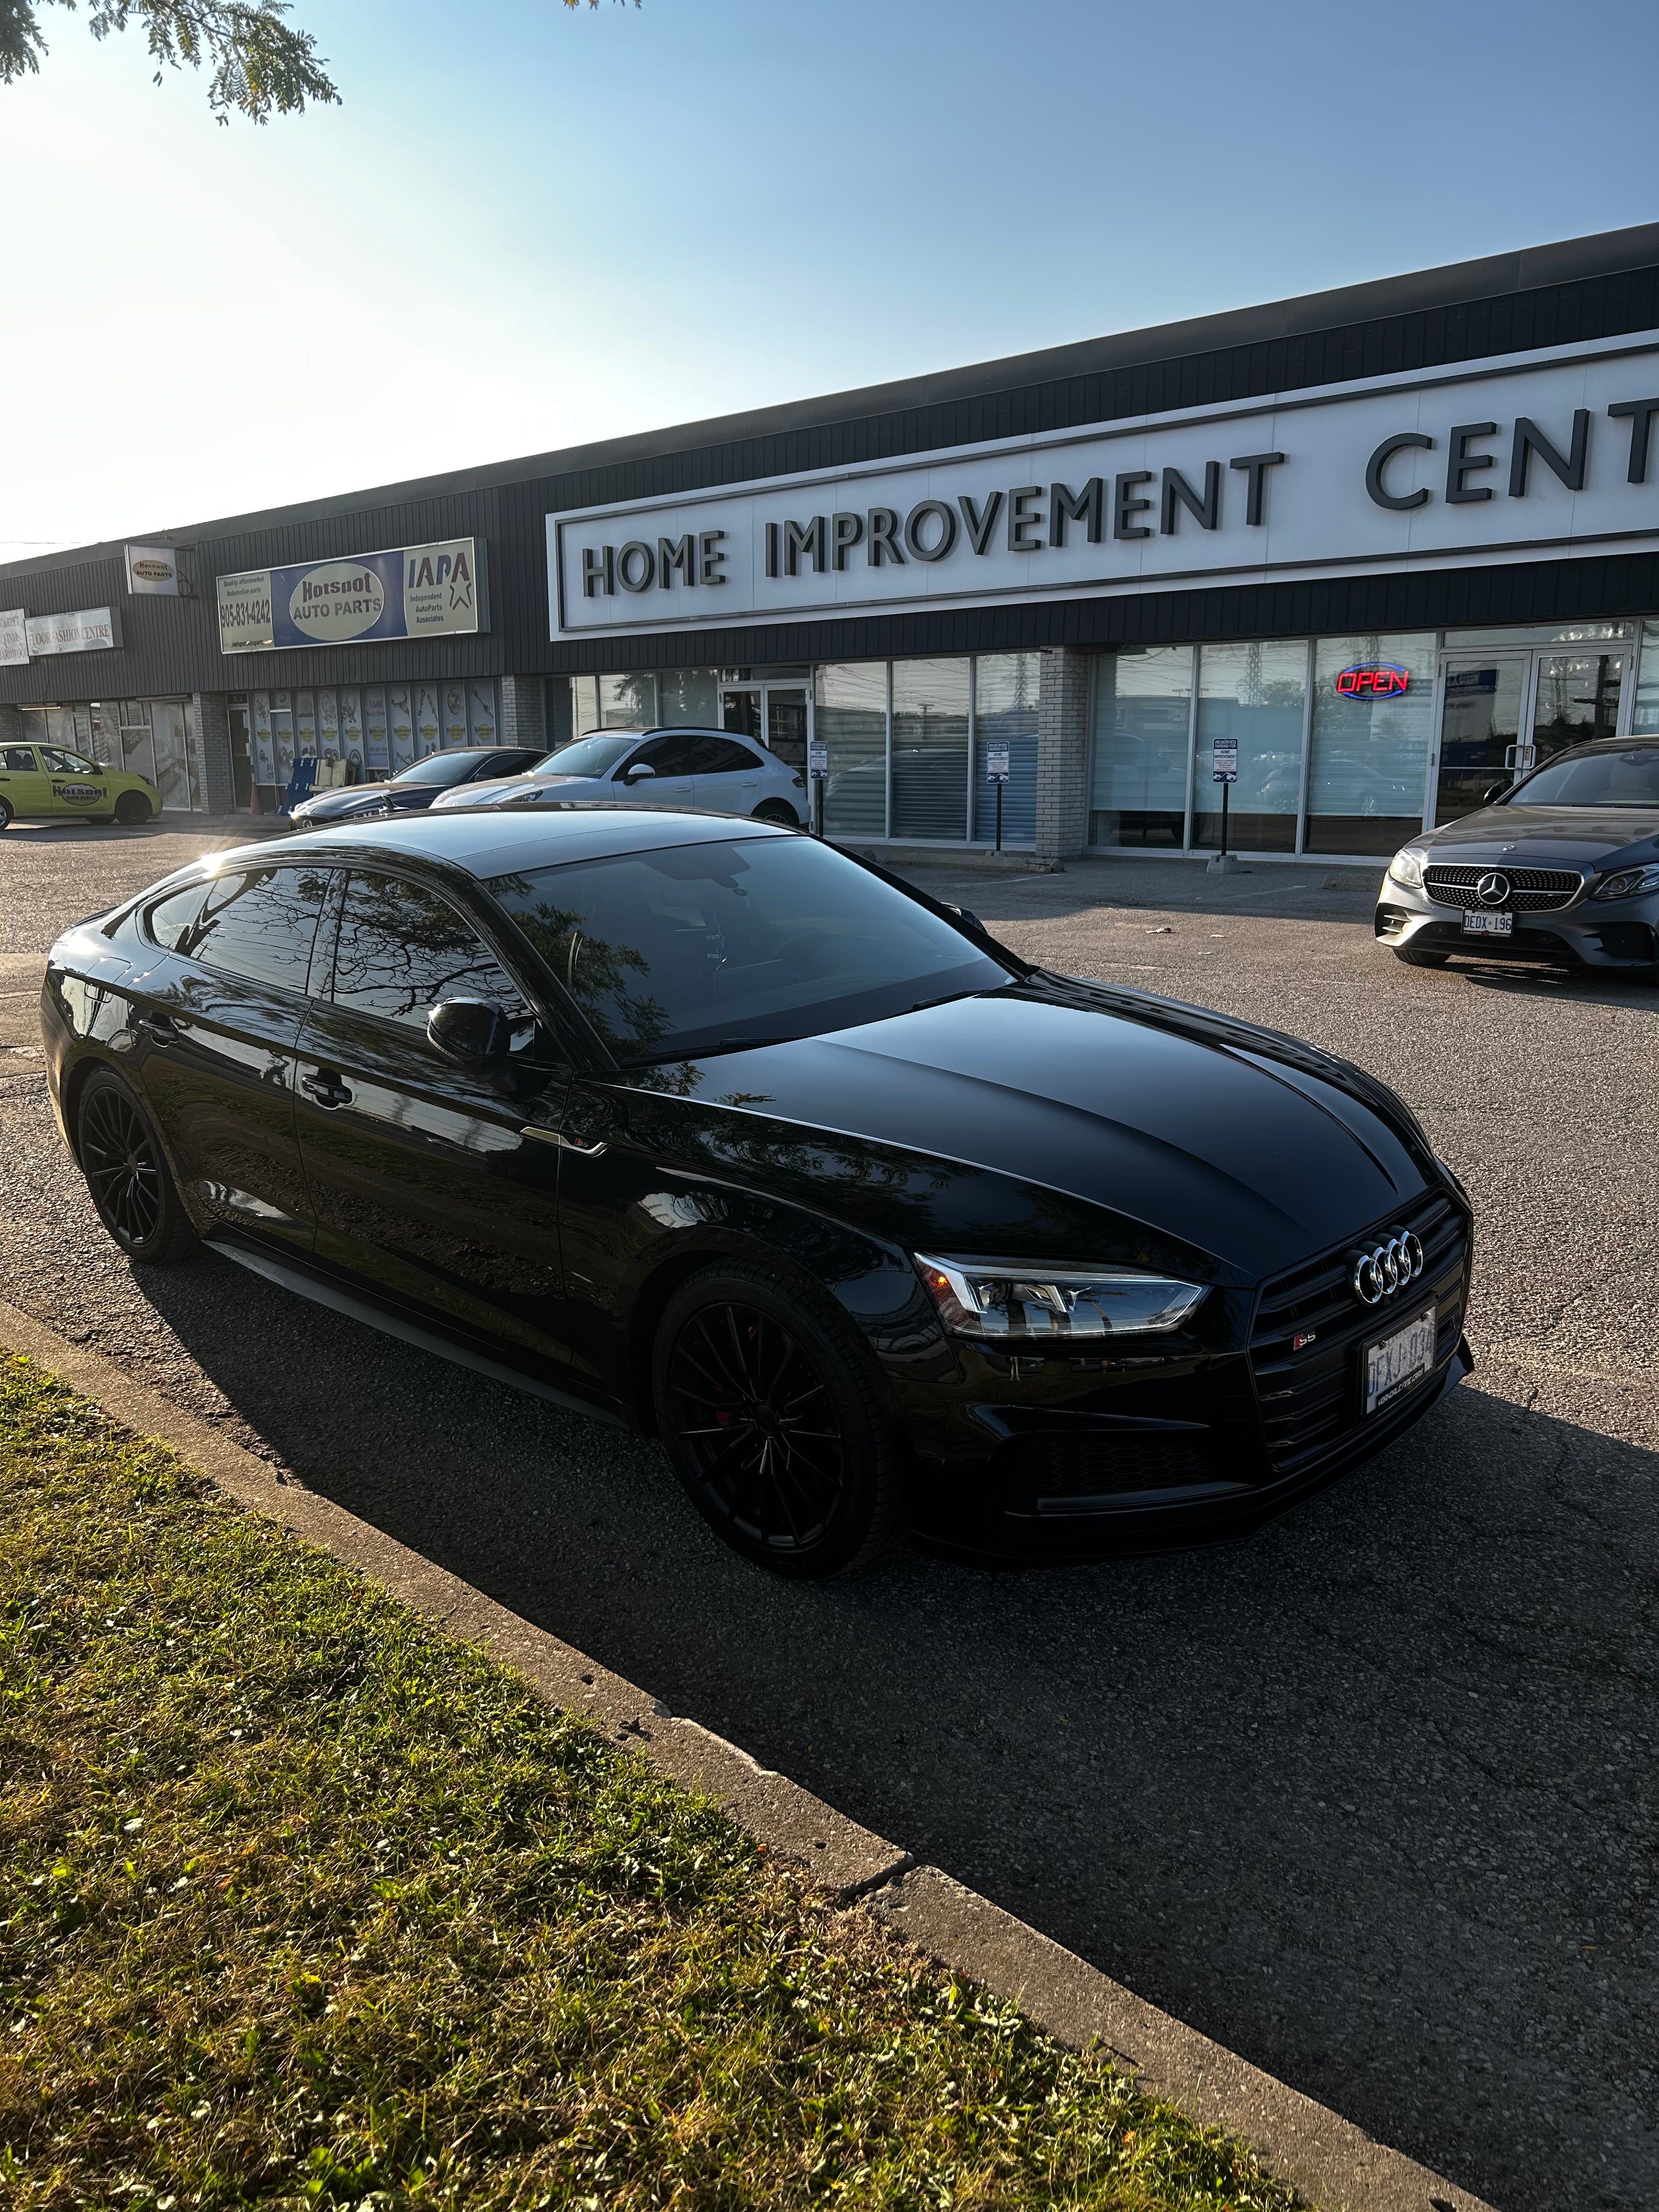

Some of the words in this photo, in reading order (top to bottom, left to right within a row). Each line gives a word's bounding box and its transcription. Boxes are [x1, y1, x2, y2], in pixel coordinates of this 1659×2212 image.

[582, 530, 726, 597] HOME
[765, 451, 1285, 578] IMPROVEMENT
[239, 577, 264, 585] aftermarket
[408, 552, 471, 589] IAPA
[227, 588, 249, 597] Automotive
[250, 587, 261, 595] parts
[302, 572, 372, 603] Hotspot
[410, 592, 442, 603] Independent
[221, 599, 271, 628] 905-831-4242
[294, 603, 330, 620] AUTO
[335, 597, 382, 616] PARTS
[416, 603, 443, 613] AutoParts
[416, 614, 444, 624] Associates
[29, 631, 52, 646] FLOOR
[53, 628, 80, 643] ASHION
[81, 624, 110, 640] CENTRE
[1337, 671, 1409, 693] OPEN
[1299, 1331, 1316, 1345] S5
